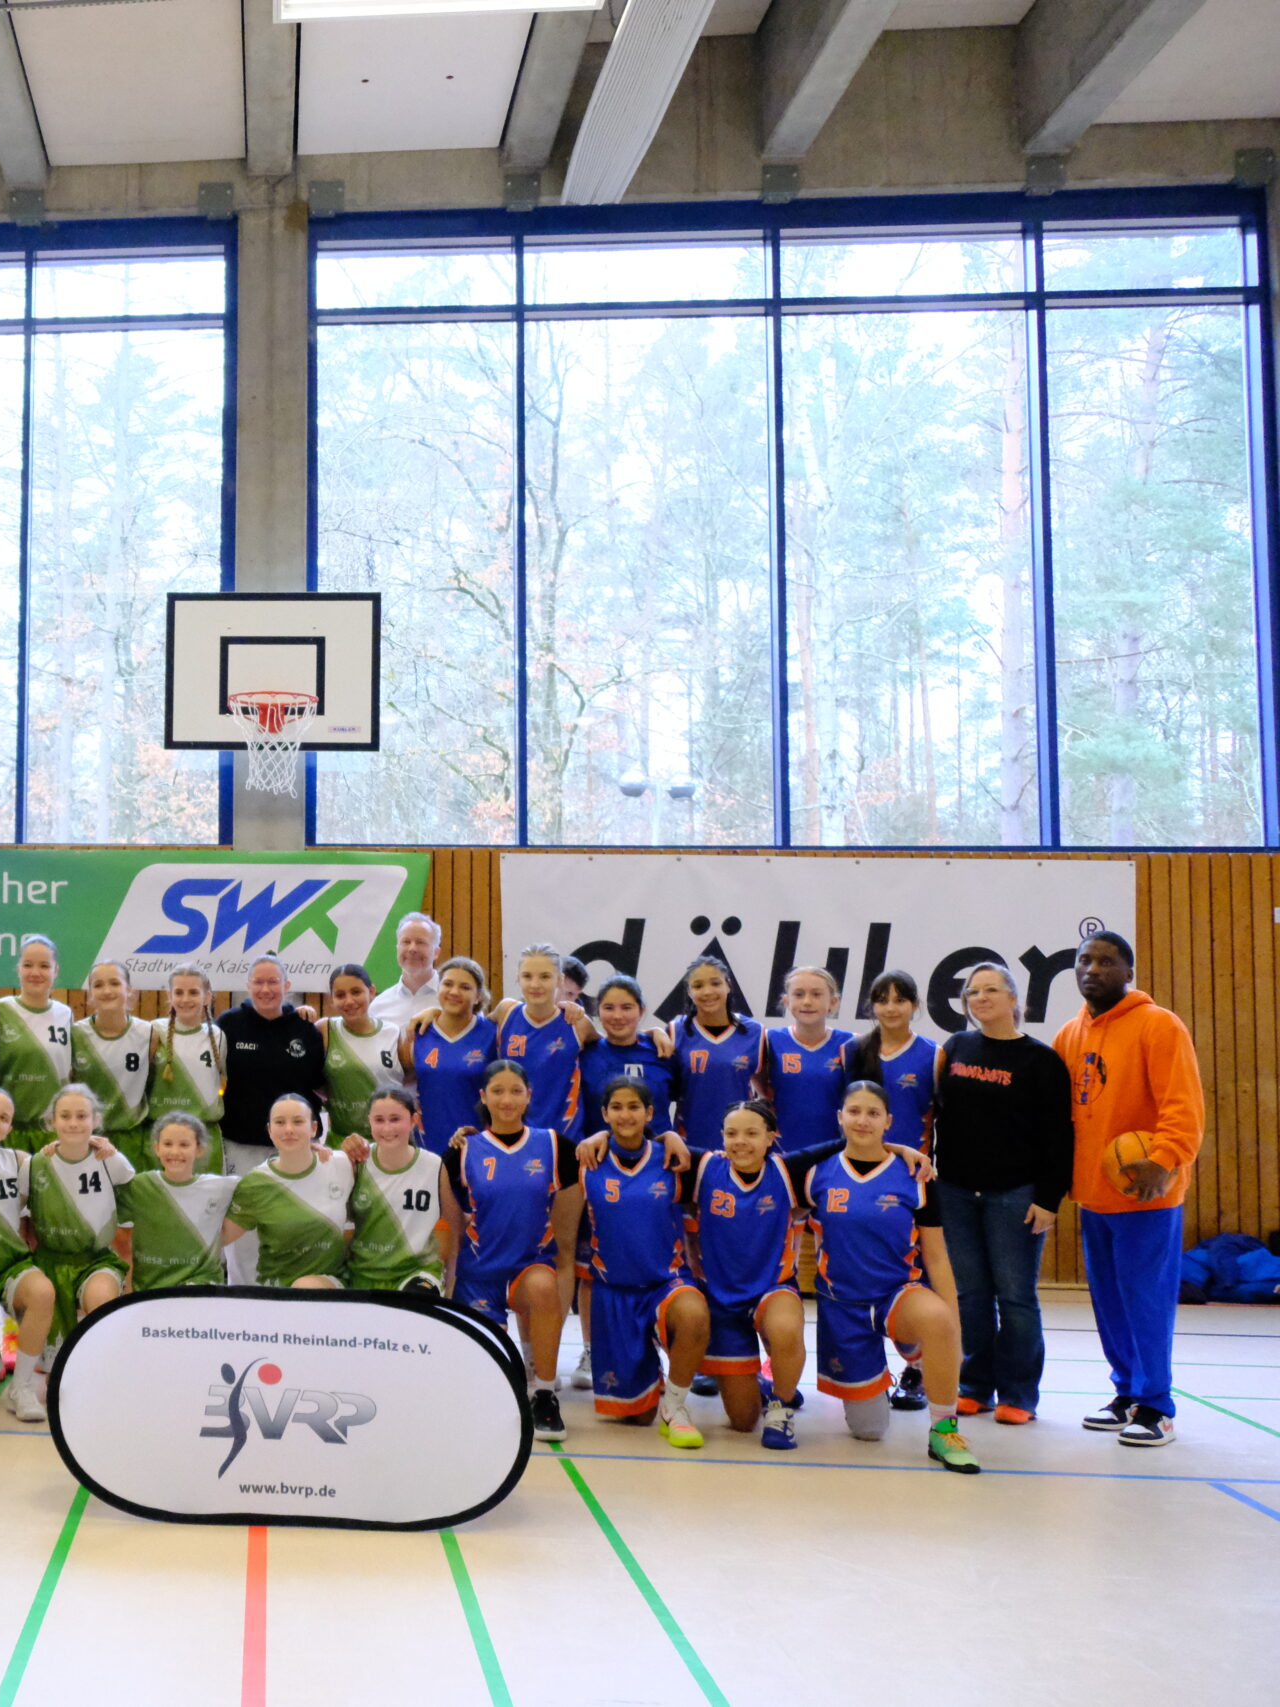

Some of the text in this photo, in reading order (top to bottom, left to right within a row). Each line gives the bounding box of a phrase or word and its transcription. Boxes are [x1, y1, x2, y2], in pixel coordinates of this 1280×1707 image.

[132, 878, 366, 955] SWK
[47, 1025, 68, 1046] 13
[506, 1034, 528, 1057] 21
[125, 1052, 140, 1073] 8
[199, 1049, 213, 1068] 4
[380, 1050, 394, 1070] 6
[423, 1047, 440, 1069] 4
[689, 1049, 710, 1074] 17
[781, 1052, 803, 1074] 15
[483, 1156, 497, 1182] 7
[78, 1171, 102, 1195] 14
[604, 1178, 621, 1203] 5
[402, 1188, 432, 1212] 10
[709, 1188, 737, 1219] 23
[826, 1187, 851, 1213] 12
[141, 1326, 432, 1355] Basketballverband Rheinland-Pfalz e. V.
[199, 1384, 378, 1445] BVRP
[238, 1481, 337, 1499] www.bvrp.de
